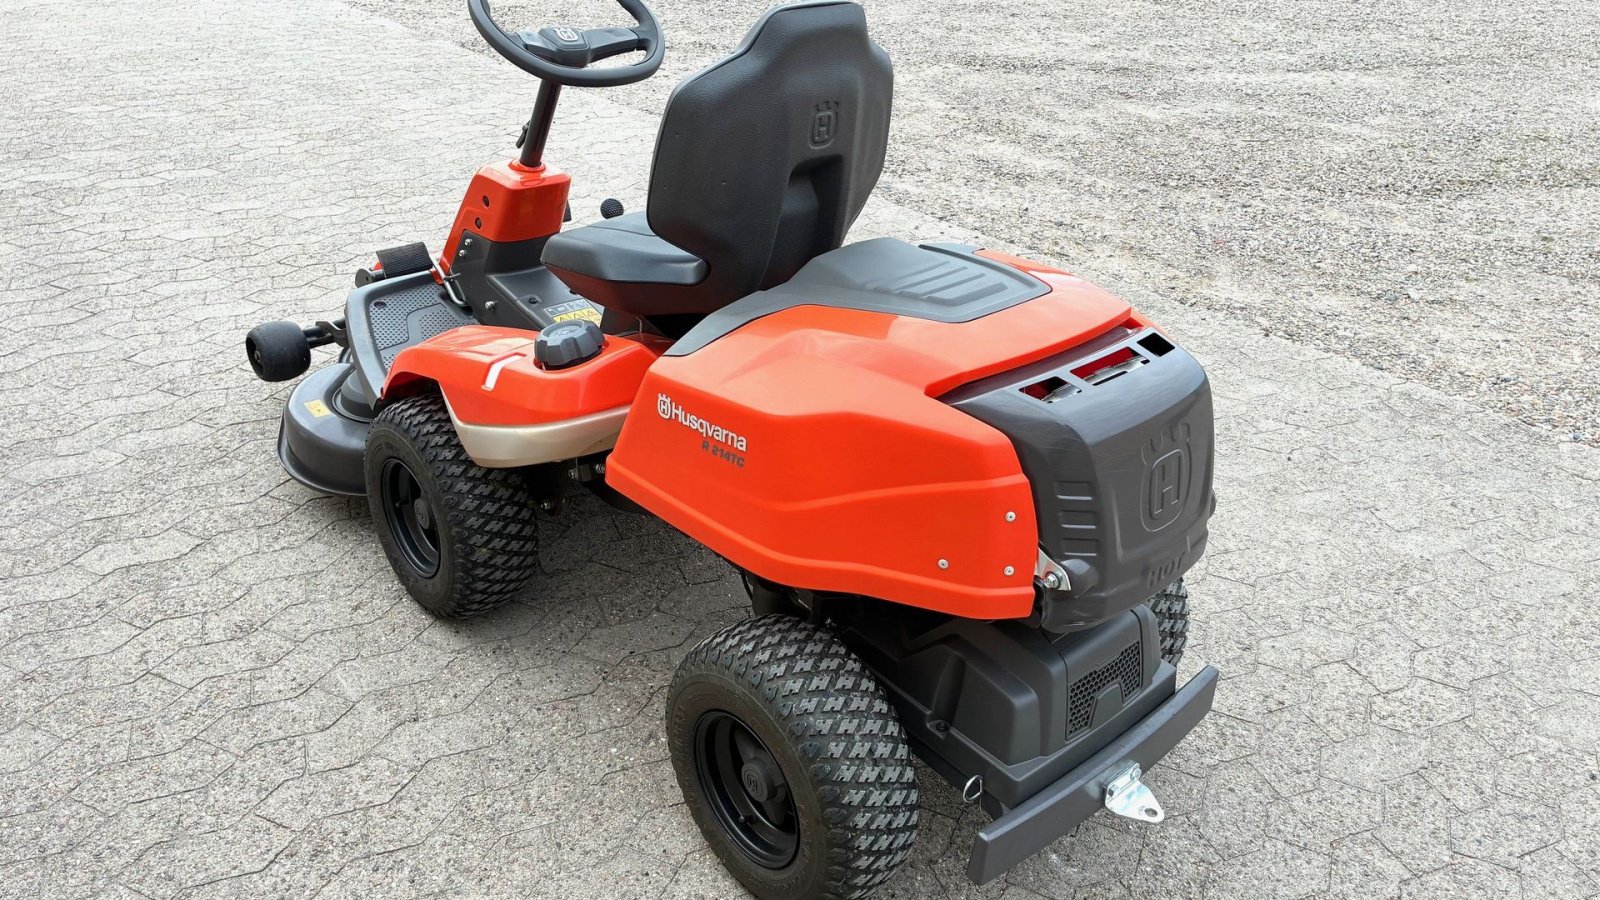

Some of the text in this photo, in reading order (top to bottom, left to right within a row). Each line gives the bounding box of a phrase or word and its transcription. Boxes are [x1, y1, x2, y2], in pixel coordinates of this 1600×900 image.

[671, 402, 747, 452] Husqvarna
[701, 440, 745, 468] R 214TC
[1147, 551, 1186, 588] HOT
